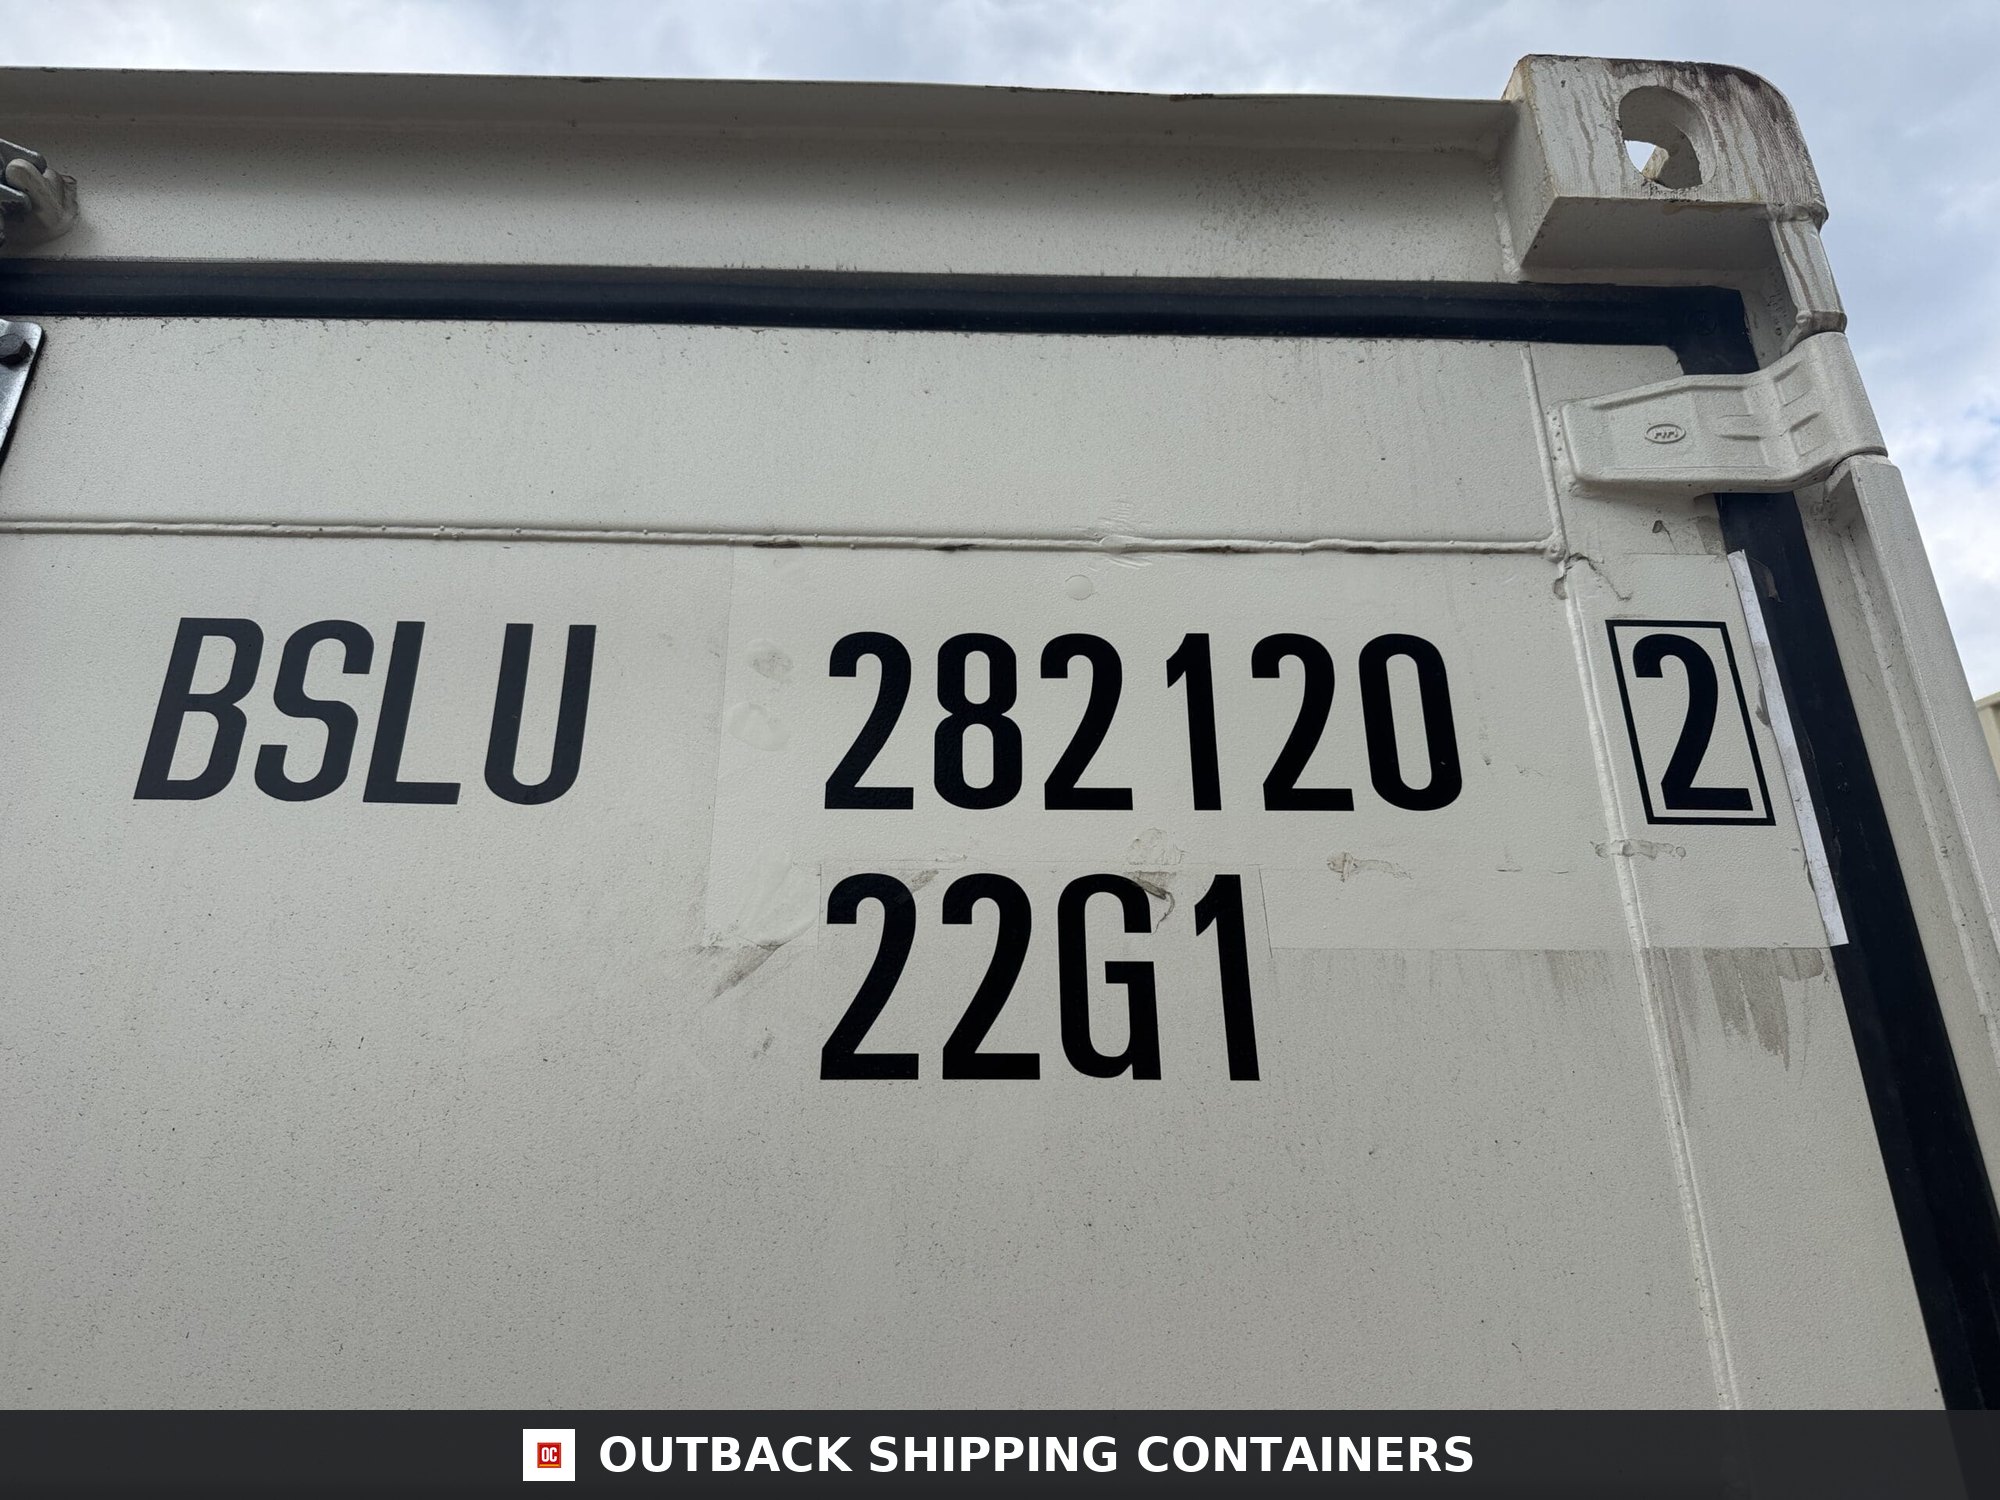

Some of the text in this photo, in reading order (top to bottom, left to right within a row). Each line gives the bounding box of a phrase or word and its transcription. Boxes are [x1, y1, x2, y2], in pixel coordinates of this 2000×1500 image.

[134, 617, 1754, 812] BSLU 282120 2
[819, 872, 1261, 1082] 22G1
